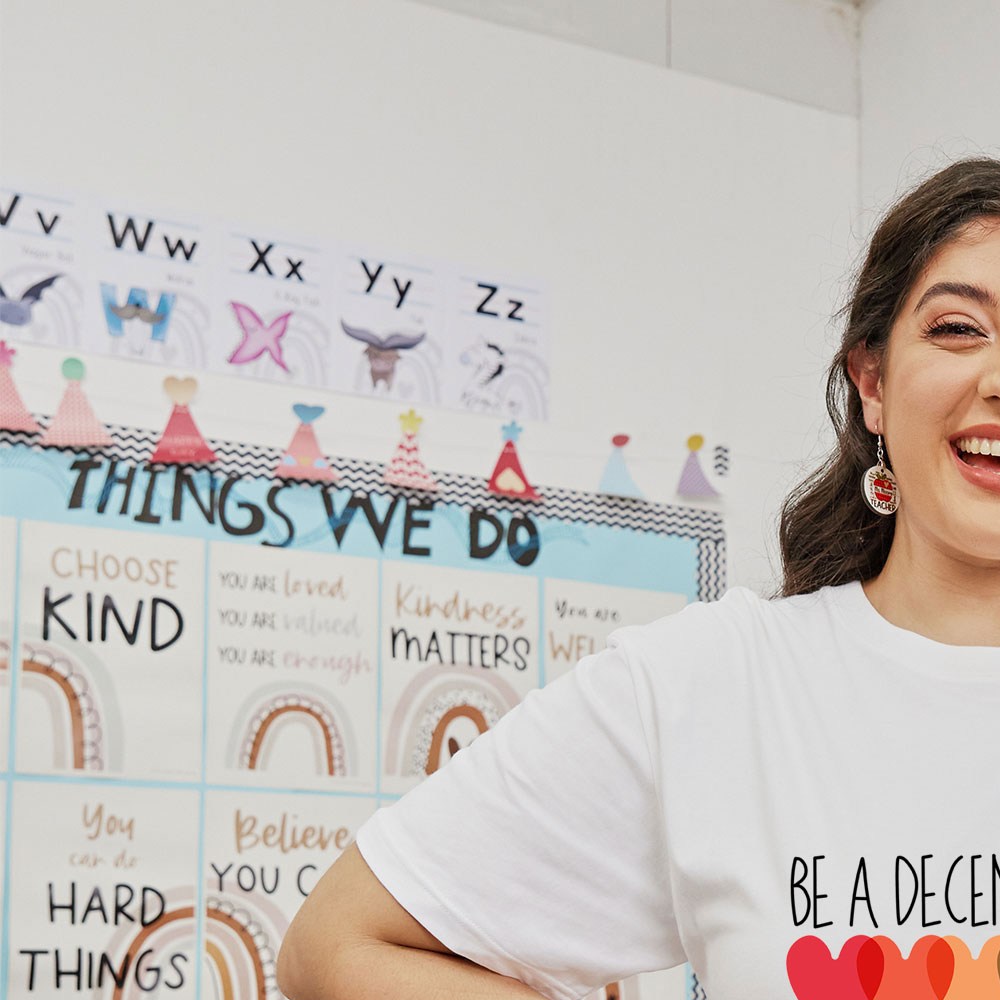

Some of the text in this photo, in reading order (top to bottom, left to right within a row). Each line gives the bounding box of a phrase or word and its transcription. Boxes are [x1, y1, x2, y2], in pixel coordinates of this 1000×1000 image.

[67, 457, 541, 567] THINGS WE DO
[50, 547, 179, 590] CHOOSE
[283, 569, 349, 601] loved
[42, 585, 185, 652] KIND
[395, 581, 527, 631] Kindness
[82, 802, 137, 841] You
[233, 808, 351, 855] Believe
[210, 862, 281, 895] YOU
[790, 854, 834, 929] BE
[849, 856, 879, 929] A
[48, 881, 166, 928] HARD
[19, 947, 190, 992] THINGS
